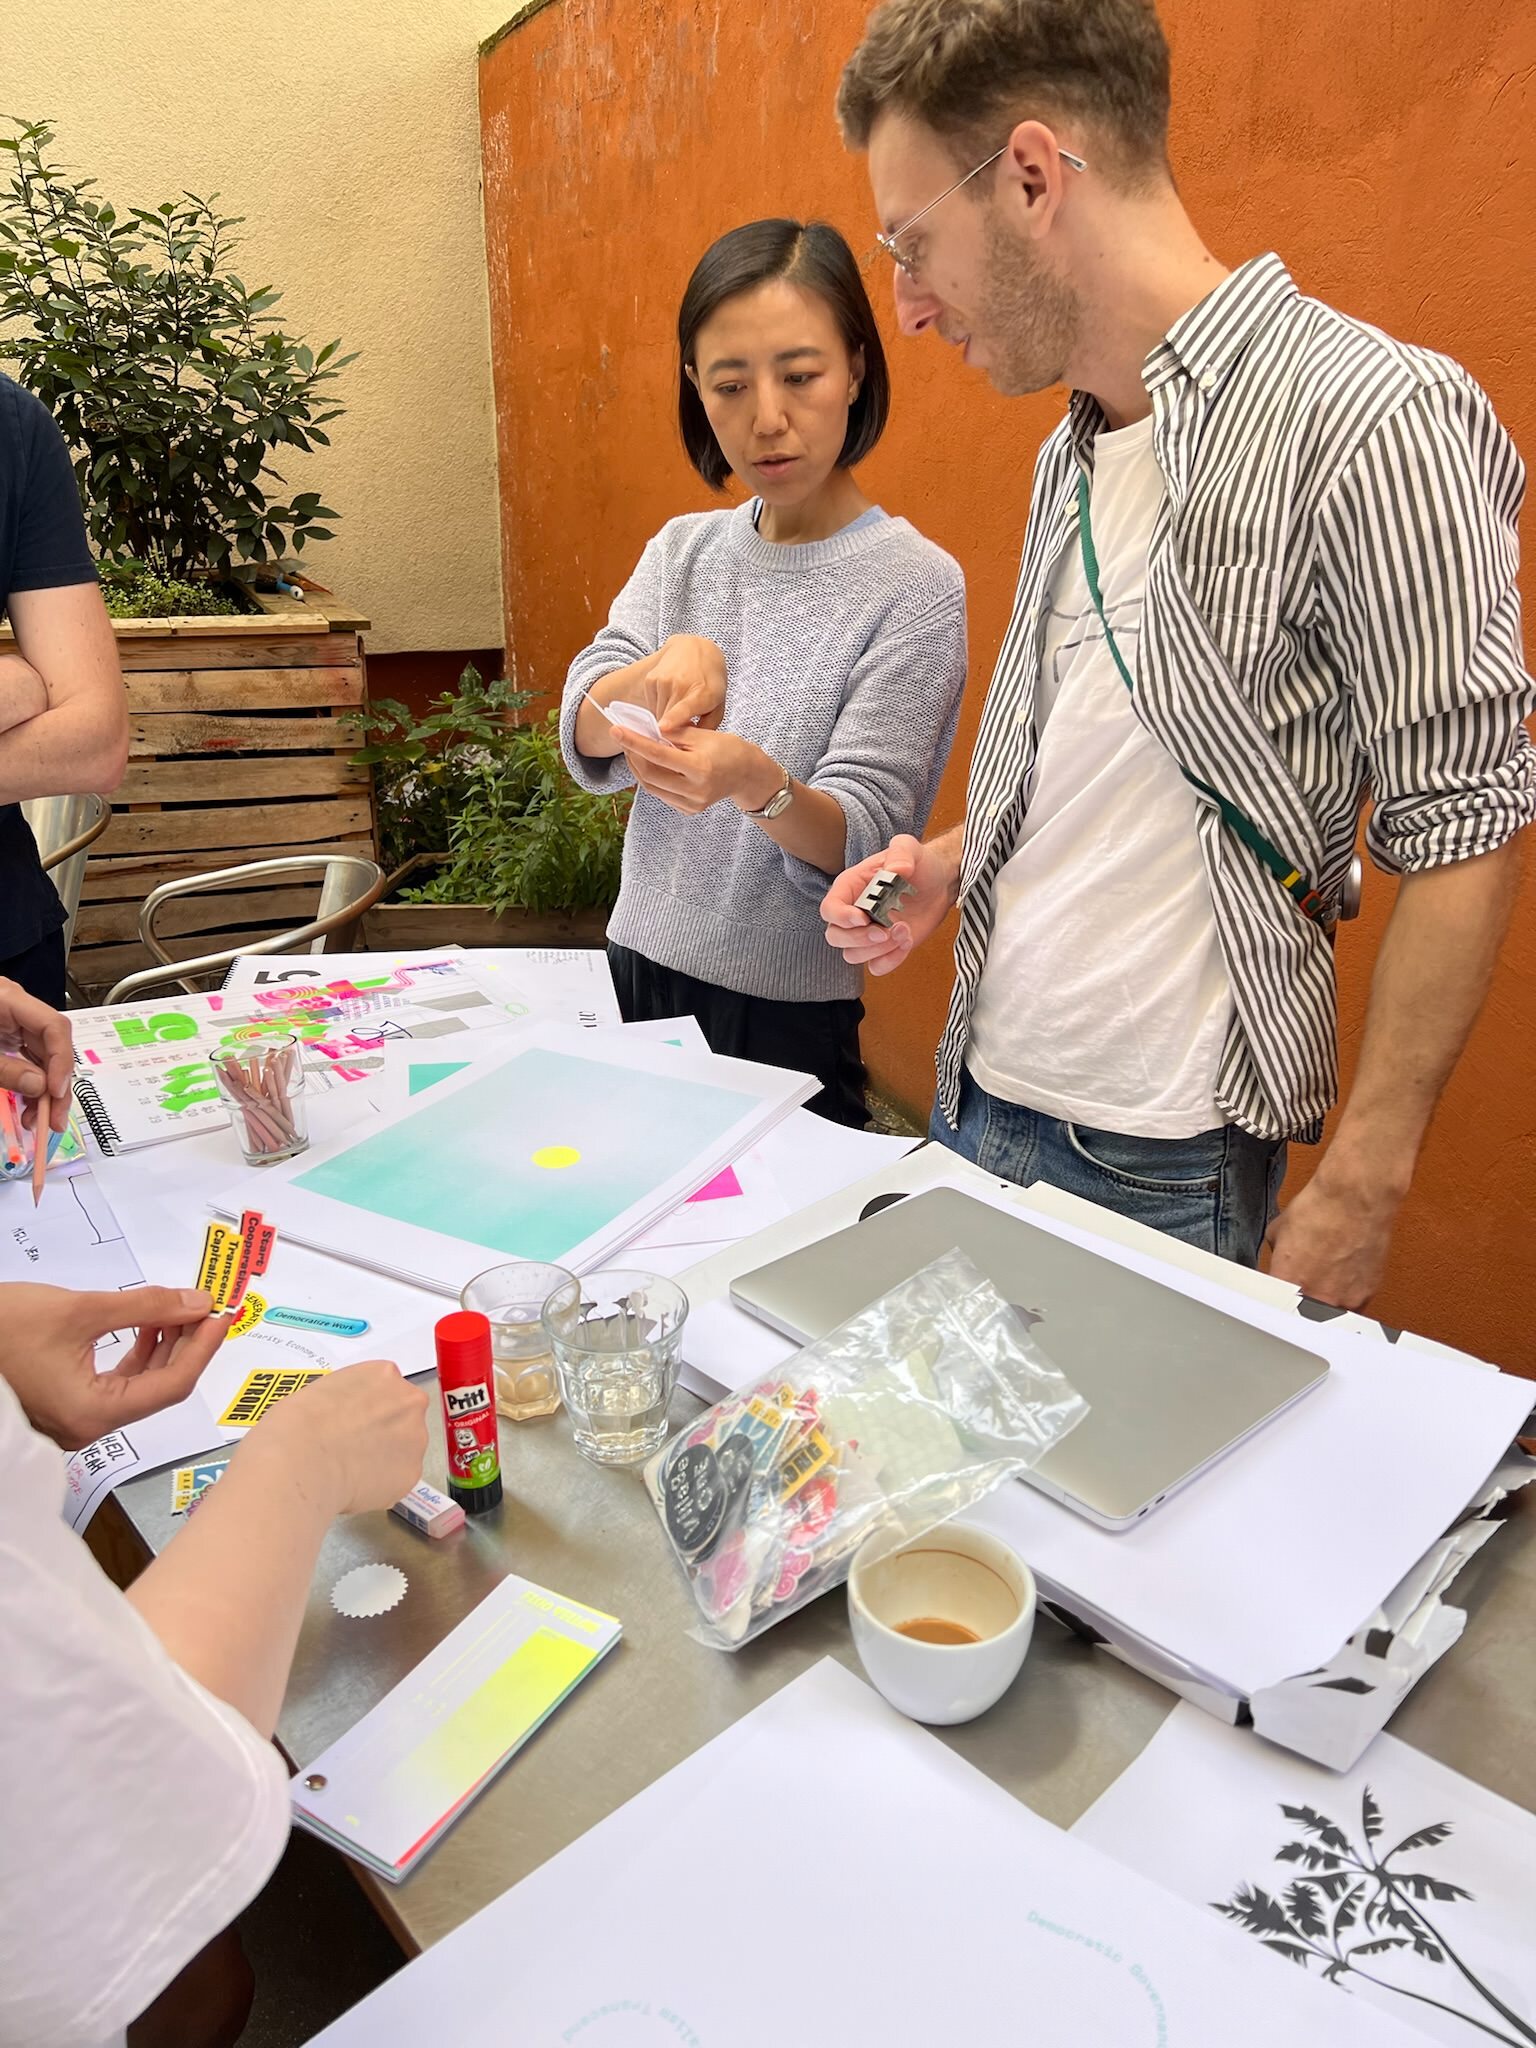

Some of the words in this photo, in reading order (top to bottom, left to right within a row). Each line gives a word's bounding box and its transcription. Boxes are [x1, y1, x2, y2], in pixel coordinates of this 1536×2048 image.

[231, 1217, 259, 1299] Cooperatives
[255, 1230, 273, 1267] Start
[216, 1240, 240, 1305] Transcend
[275, 1311, 330, 1327] Democratize
[332, 1322, 356, 1332] Work
[285, 1340, 317, 1359] Economy
[226, 1373, 275, 1421] STRONG
[447, 1388, 485, 1410] Pritt
[454, 1411, 490, 1428] ORIGINAL
[80, 1442, 107, 1476] YEAH
[98, 1435, 125, 1462] HELL
[671, 1456, 700, 1541] Village
[1027, 1909, 1123, 1963] Democratic
